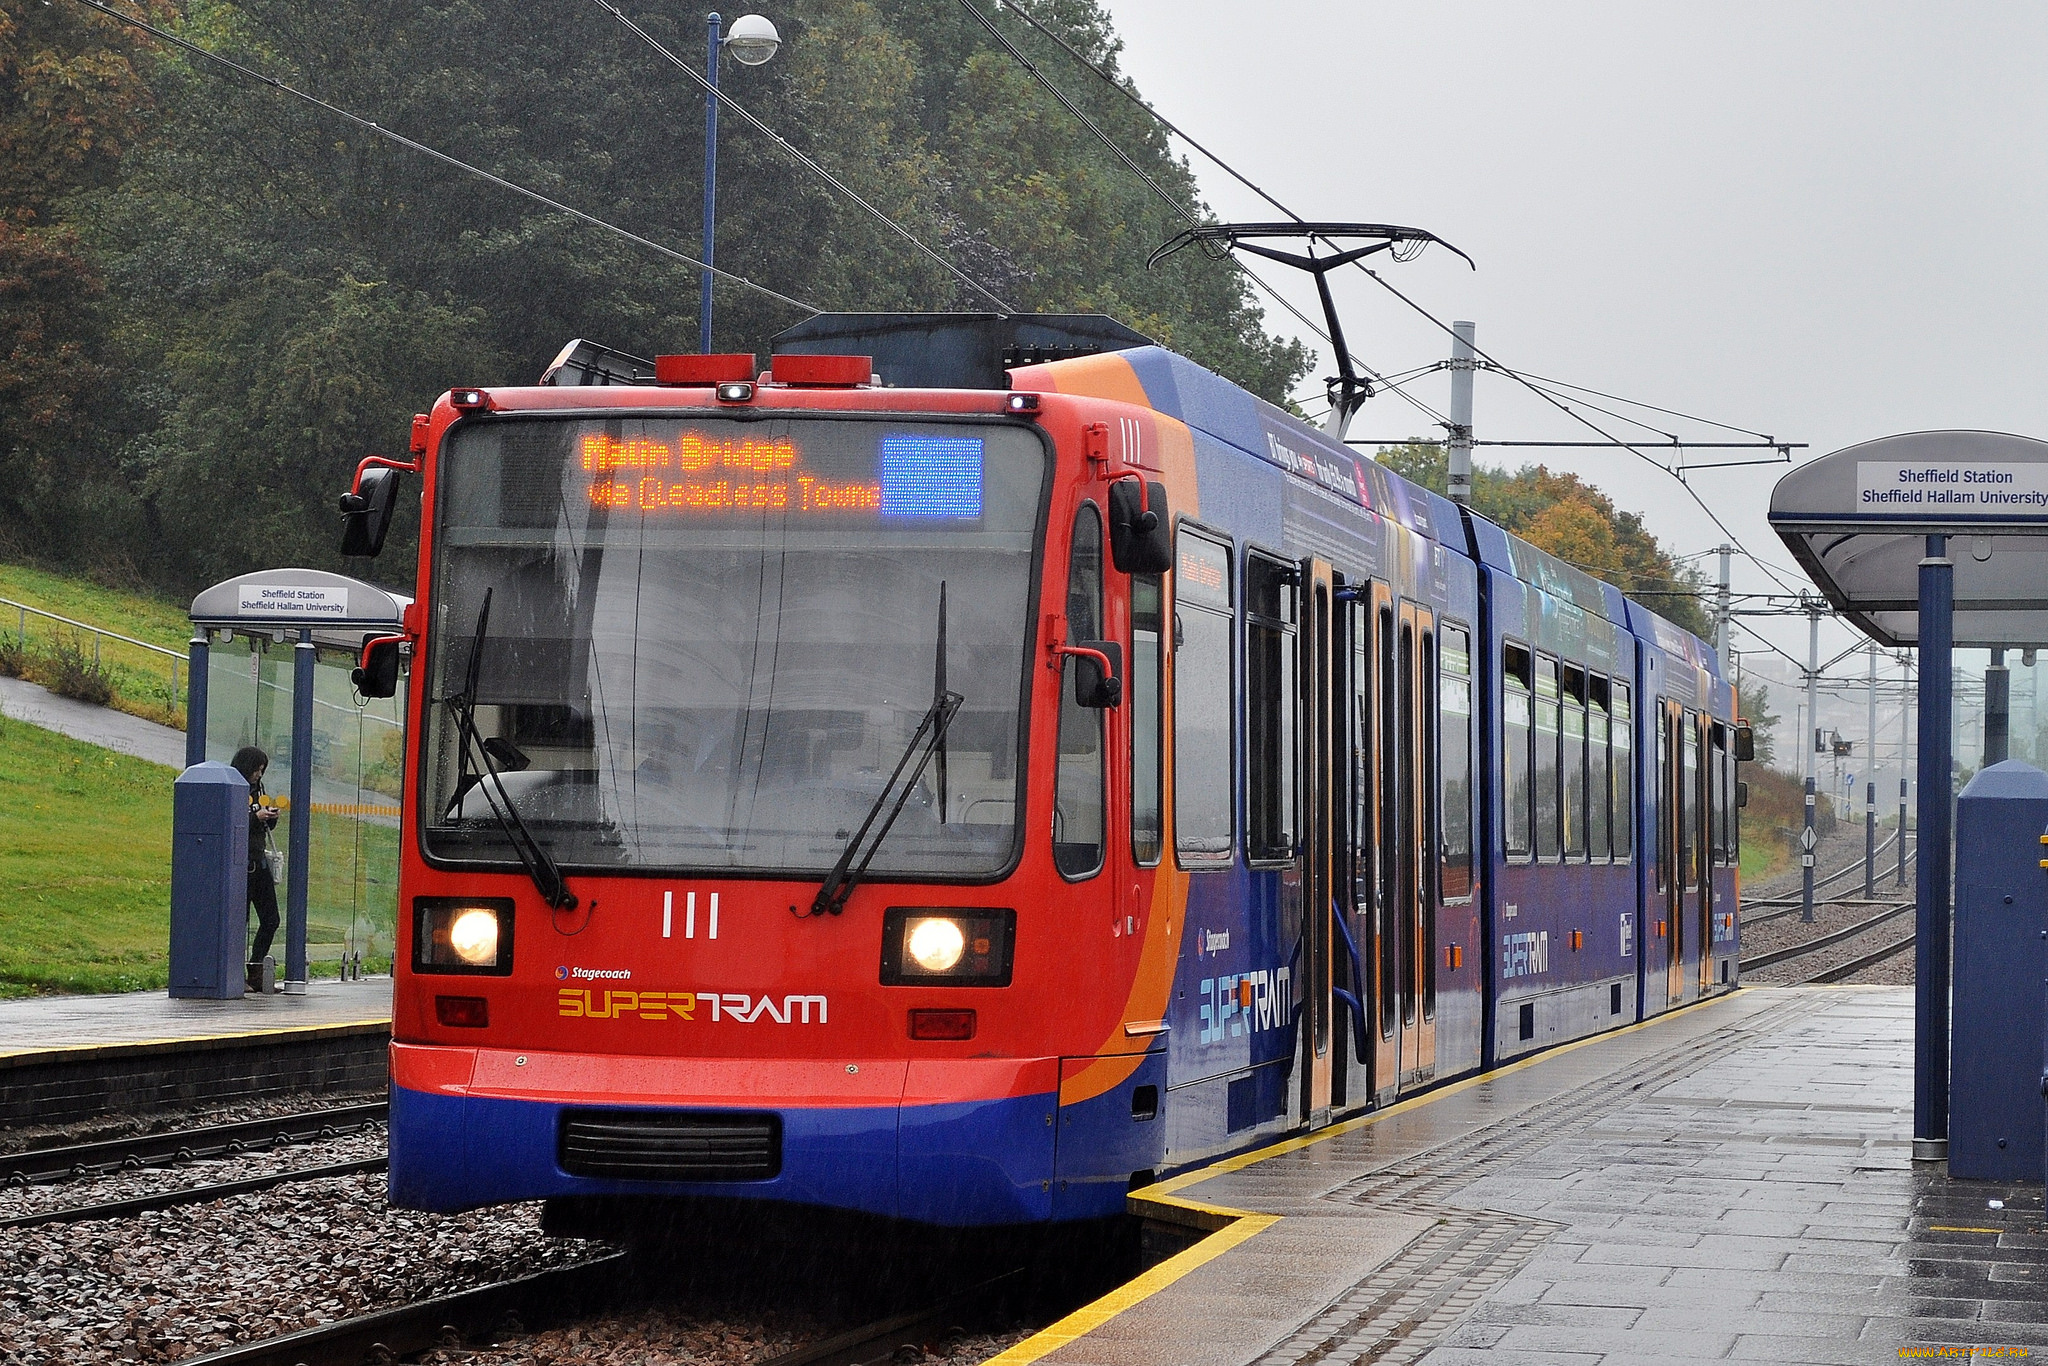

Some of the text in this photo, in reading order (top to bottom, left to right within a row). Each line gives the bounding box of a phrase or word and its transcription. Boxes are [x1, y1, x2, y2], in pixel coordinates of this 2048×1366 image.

[583, 436, 794, 470] Malin Bridge
[1898, 469, 2013, 484] Sheffield Station
[588, 480, 629, 506] via
[639, 476, 787, 509] Gleadless
[1862, 489, 2048, 507] Sheffield Hallam University
[261, 589, 325, 600] Sheffield Station
[241, 601, 345, 613] Sheffield Hallam University
[571, 966, 631, 981] Stagecoach
[558, 988, 828, 1024] SUPERTRAM
